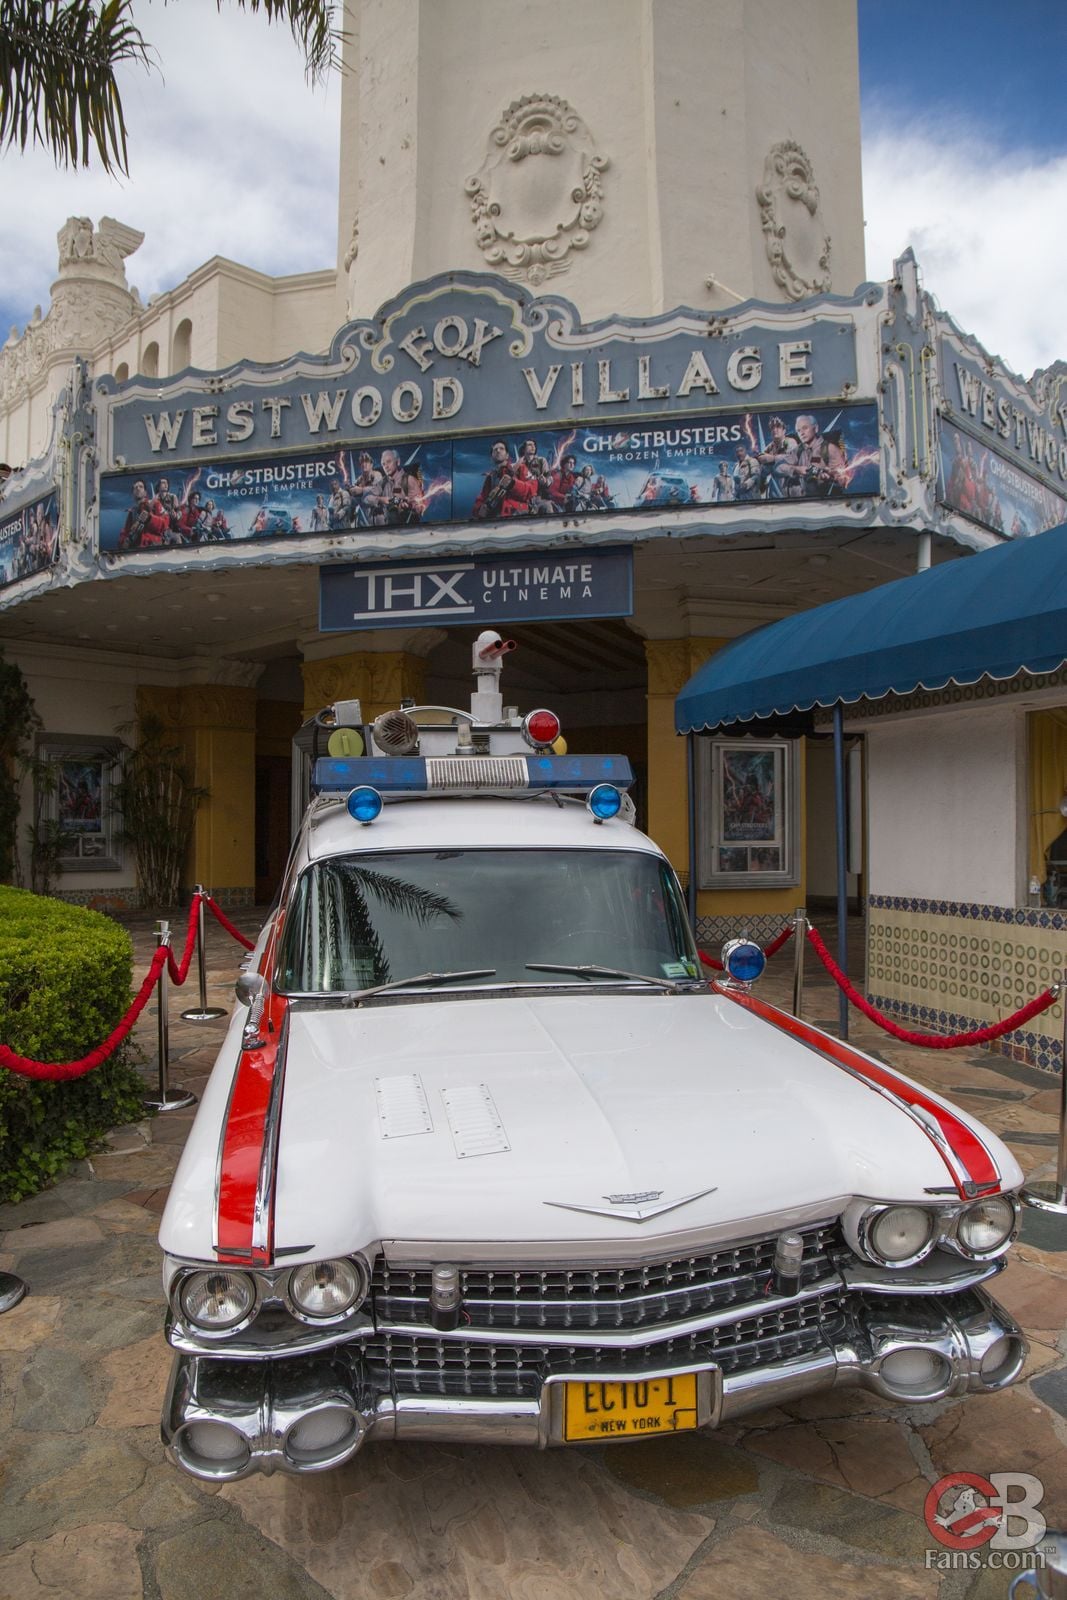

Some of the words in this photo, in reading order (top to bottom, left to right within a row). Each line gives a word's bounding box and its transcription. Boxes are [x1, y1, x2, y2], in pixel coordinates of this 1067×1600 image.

[398, 315, 503, 373] FOX
[142, 376, 465, 452] WESTWOOD
[521, 339, 814, 410] VILLAGE
[609, 450, 660, 462] FROZEN
[666, 446, 714, 458] EMPIRE
[227, 486, 268, 497] FROZEN
[274, 480, 313, 492] EMPIRE
[0, 518, 22, 541] USTERS
[353, 562, 475, 610] THX
[482, 563, 593, 588] ULTIMATE
[482, 584, 592, 603] CINEMA
[601, 1419, 626, 1433] NEW
[632, 1416, 661, 1430] YORK
